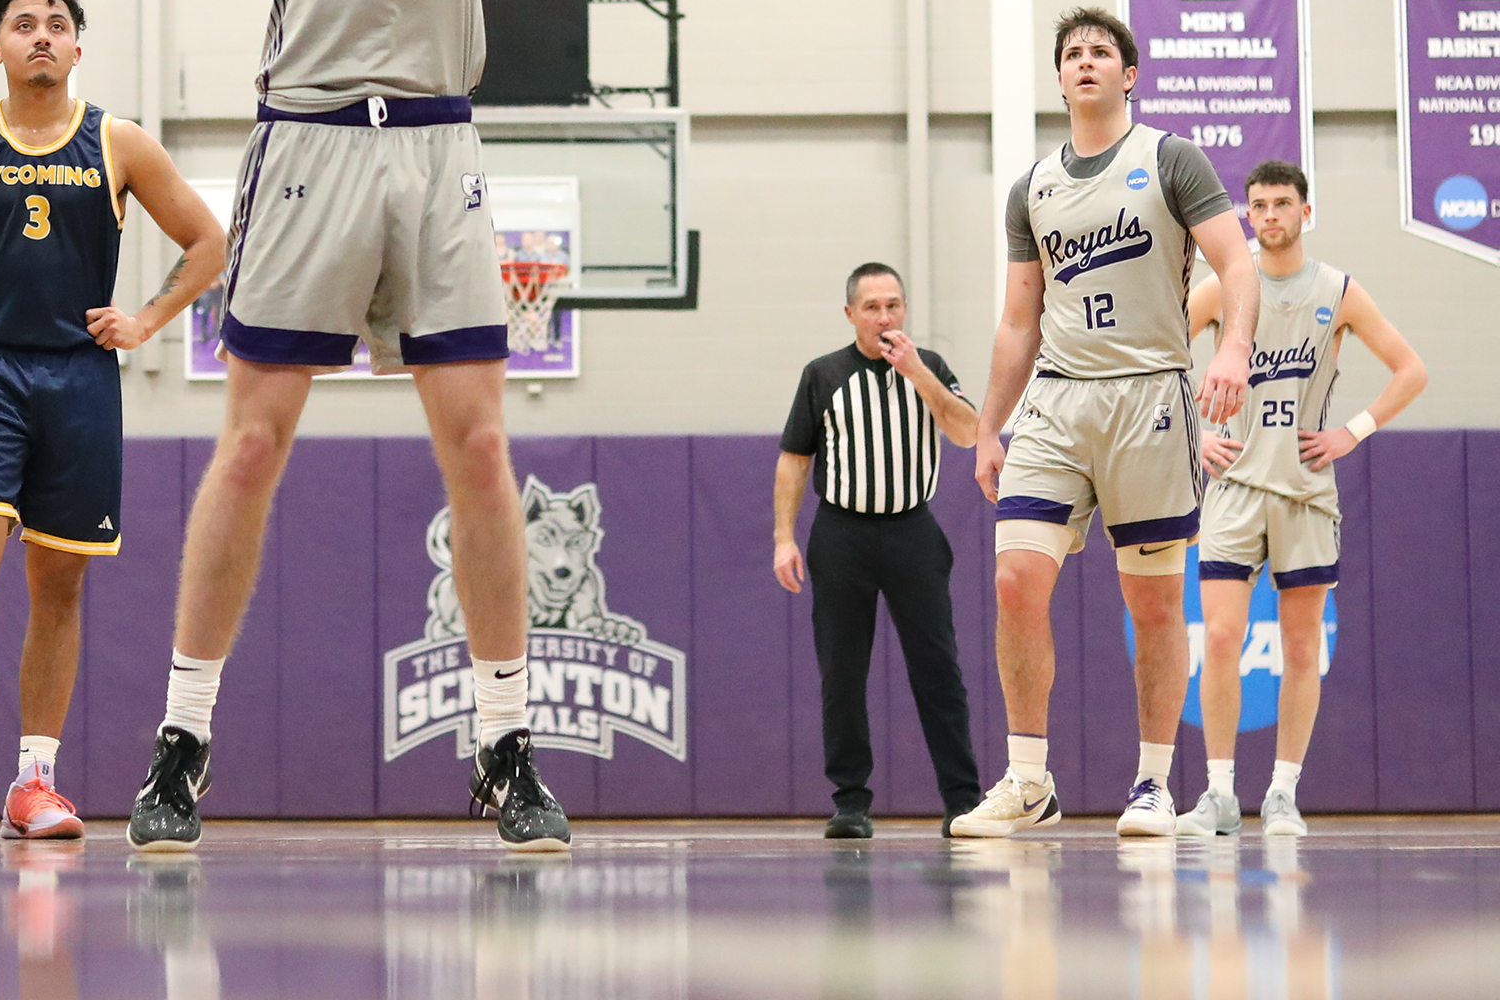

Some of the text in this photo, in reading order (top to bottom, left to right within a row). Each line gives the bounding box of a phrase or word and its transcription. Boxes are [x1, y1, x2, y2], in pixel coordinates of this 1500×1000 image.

[1180, 11, 1246, 32] MEN'S
[1149, 37, 1278, 59] BASKETBALL
[1156, 76, 1196, 92] NCAA
[1197, 76, 1257, 92] DIVISION
[1435, 74, 1474, 91] NCAA
[1139, 97, 1291, 114] NATIONAL CHAMPIONS
[1418, 96, 1486, 113] NATIONAL
[1191, 125, 1243, 148] 1976
[22, 195, 51, 240] 3
[1439, 199, 1488, 219] NCAA
[1041, 207, 1151, 269] Royals
[1083, 293, 1116, 330] 12
[1262, 401, 1295, 427] 25
[411, 646, 460, 678] THE
[629, 650, 658, 678] OF
